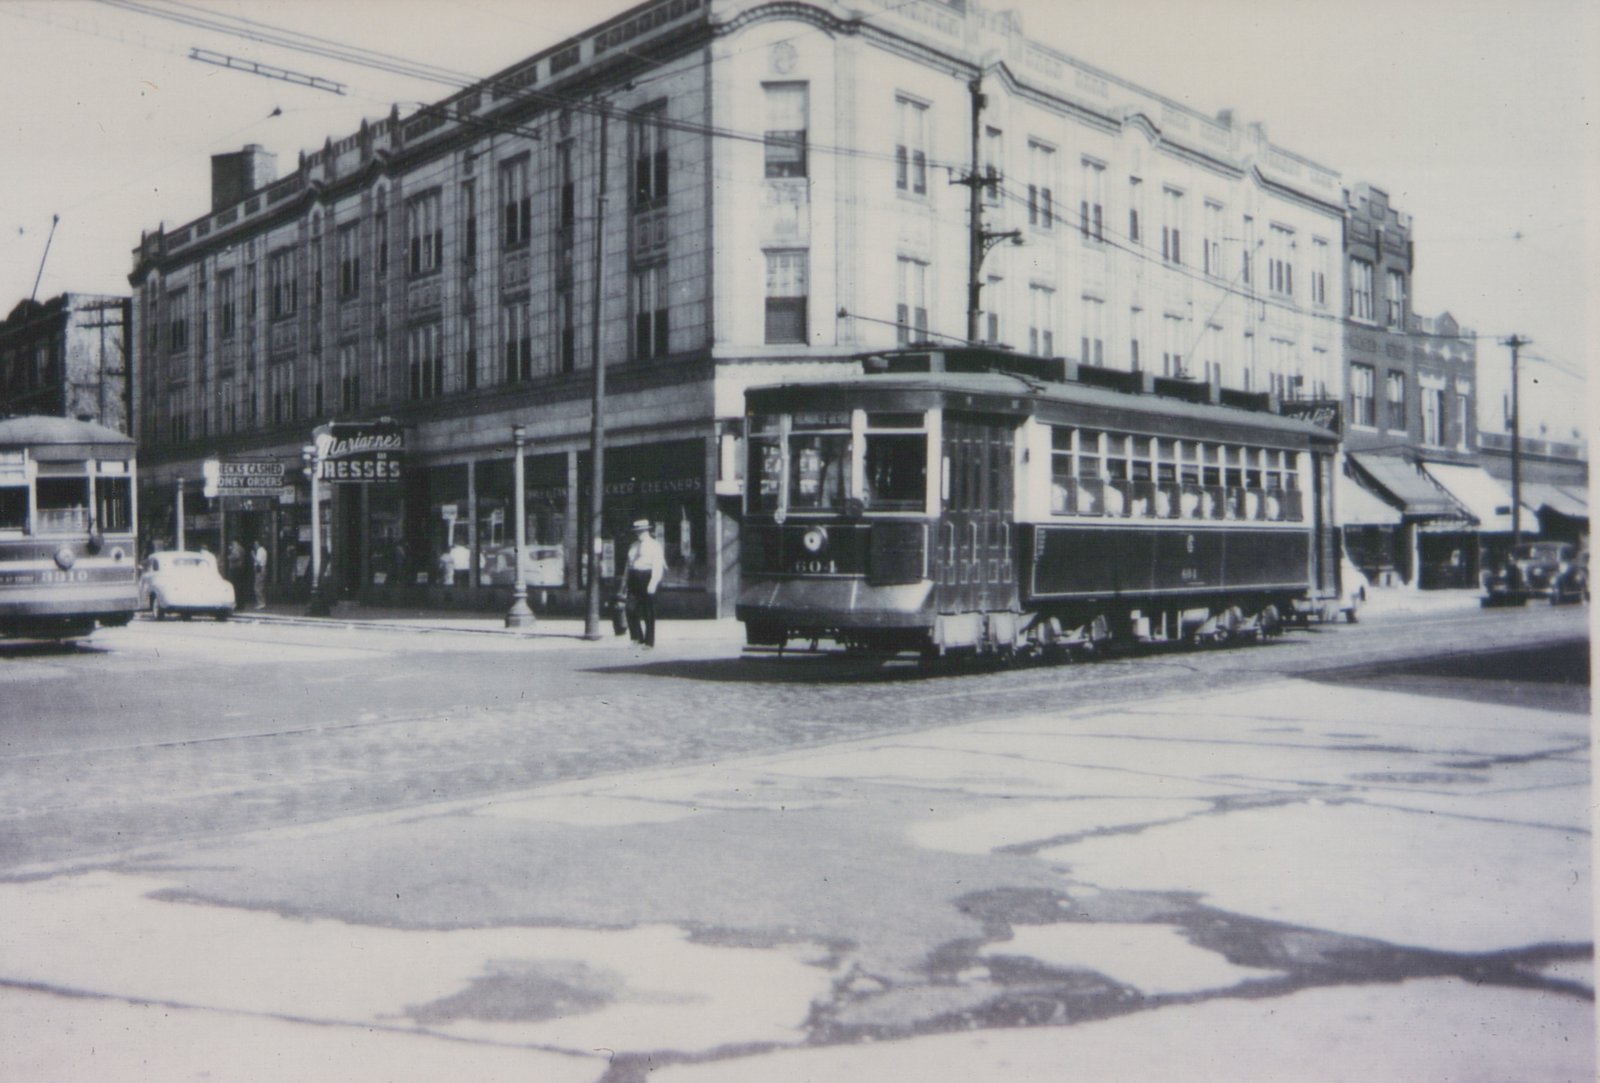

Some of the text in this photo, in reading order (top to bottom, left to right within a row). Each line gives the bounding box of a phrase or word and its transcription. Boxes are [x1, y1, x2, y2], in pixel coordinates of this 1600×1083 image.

[248, 463, 282, 475] CASHED
[318, 461, 400, 478] RESSES
[218, 476, 282, 487] ONEY ORDERS
[584, 482, 635, 496] CCKER
[641, 477, 701, 494] CLEANERS
